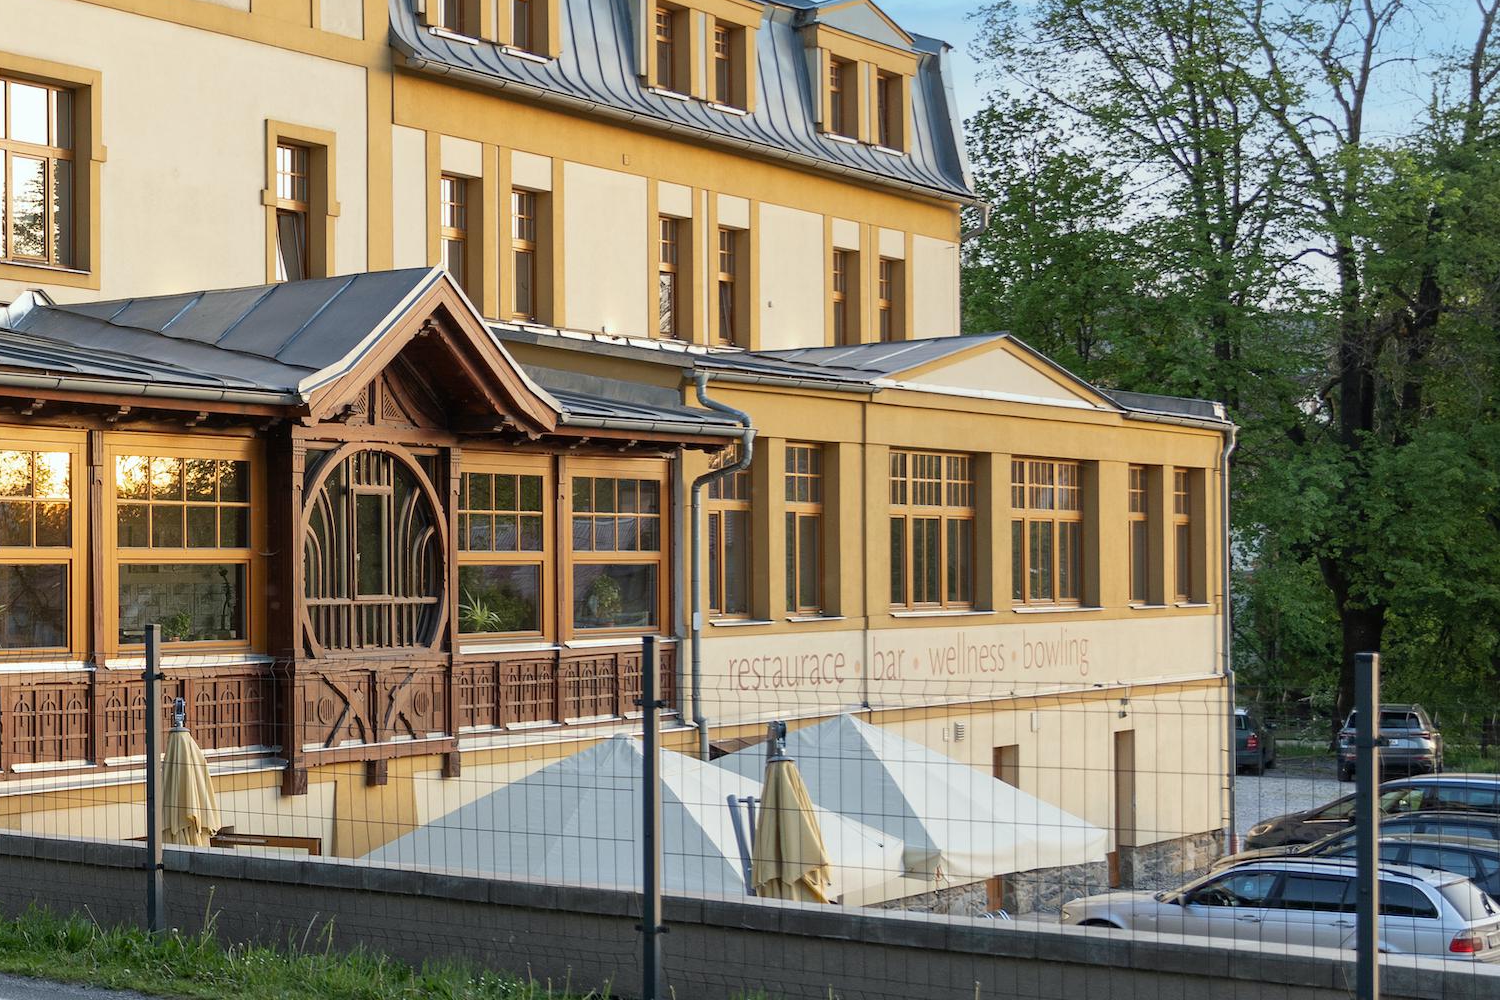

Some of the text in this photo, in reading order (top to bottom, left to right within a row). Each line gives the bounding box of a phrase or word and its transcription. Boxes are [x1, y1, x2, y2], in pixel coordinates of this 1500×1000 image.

[728, 628, 1090, 691] restaurace bar wellness bowling
